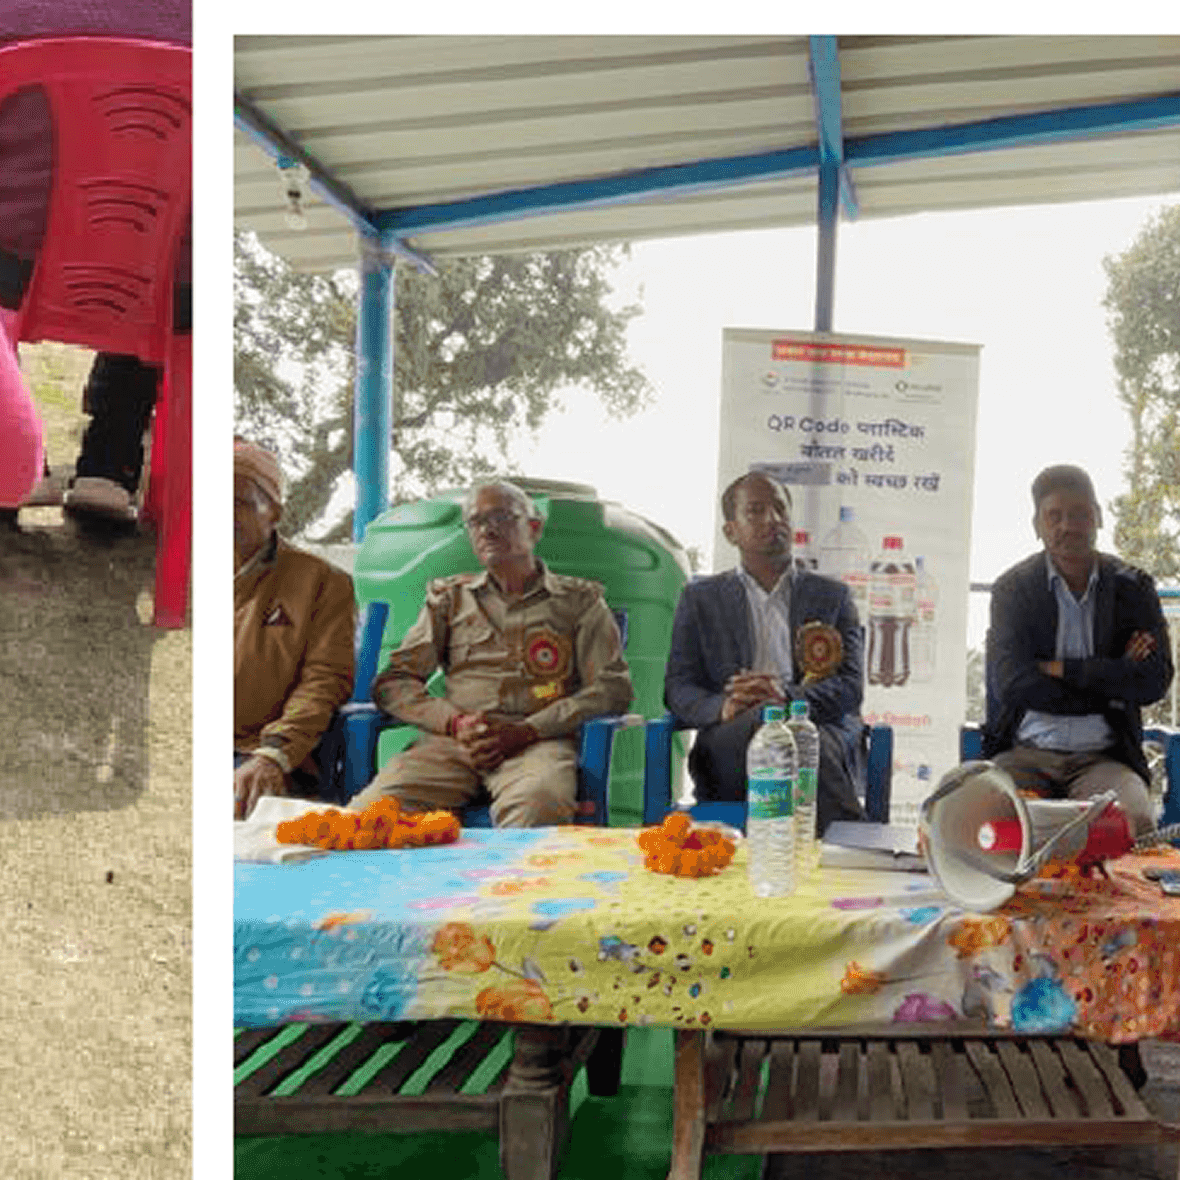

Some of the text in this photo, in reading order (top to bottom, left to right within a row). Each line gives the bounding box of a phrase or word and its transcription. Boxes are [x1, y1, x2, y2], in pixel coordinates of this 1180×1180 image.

[768, 414, 926, 439] QR Code प्लास्टिक
[801, 439, 848, 459] बोतल
[835, 467, 859, 487] को
[865, 474, 908, 489] स्वच्छ
